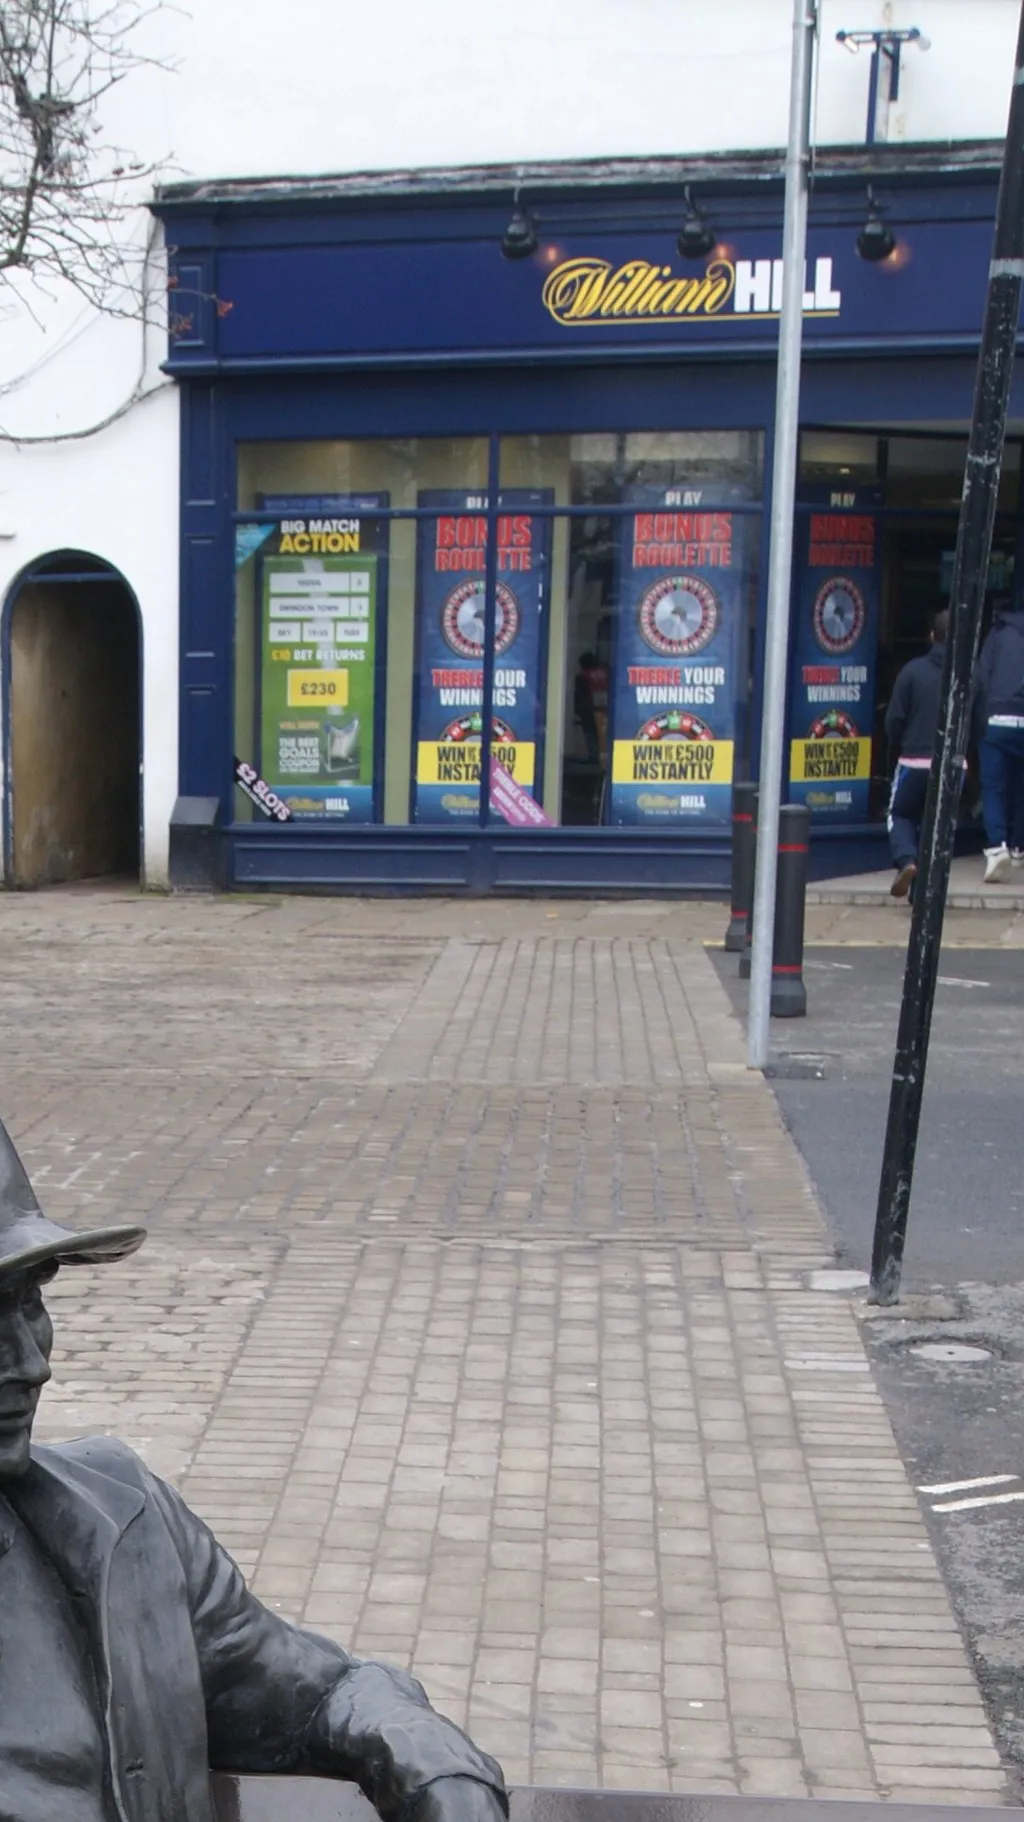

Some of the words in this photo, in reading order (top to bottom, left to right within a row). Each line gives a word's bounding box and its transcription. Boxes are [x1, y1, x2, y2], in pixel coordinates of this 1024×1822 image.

[543, 258, 734, 320] William
[664, 491, 702, 507] PLAY
[280, 520, 306, 534] BIG
[309, 519, 360, 533] MATCH
[436, 514, 532, 548] BONUS
[633, 513, 732, 543] BONUS
[279, 533, 360, 554] ACTION
[435, 547, 532, 572] ROULTTE
[632, 542, 732, 568] ROULETTE
[293, 649, 313, 661] BET
[315, 649, 365, 661] RETURNS
[494, 669, 526, 688] OUR
[628, 667, 681, 686] TREBLE
[684, 667, 725, 685] YOUR
[841, 666, 867, 683] YOUR
[300, 682, 337, 696] £230
[440, 688, 516, 706] WINNGS
[636, 686, 715, 704] WINNINGS
[807, 684, 860, 702] WINNINGS
[437, 746, 466, 762] WIN
[632, 745, 663, 761] WIN
[676, 744, 715, 761] £500
[804, 743, 825, 759] WIN
[632, 761, 714, 781] INSTANTLY
[804, 758, 858, 778] INSTANTLY
[252, 779, 292, 821] SLOTS
[325, 797, 349, 811] HILL
[680, 795, 706, 808] HILL
